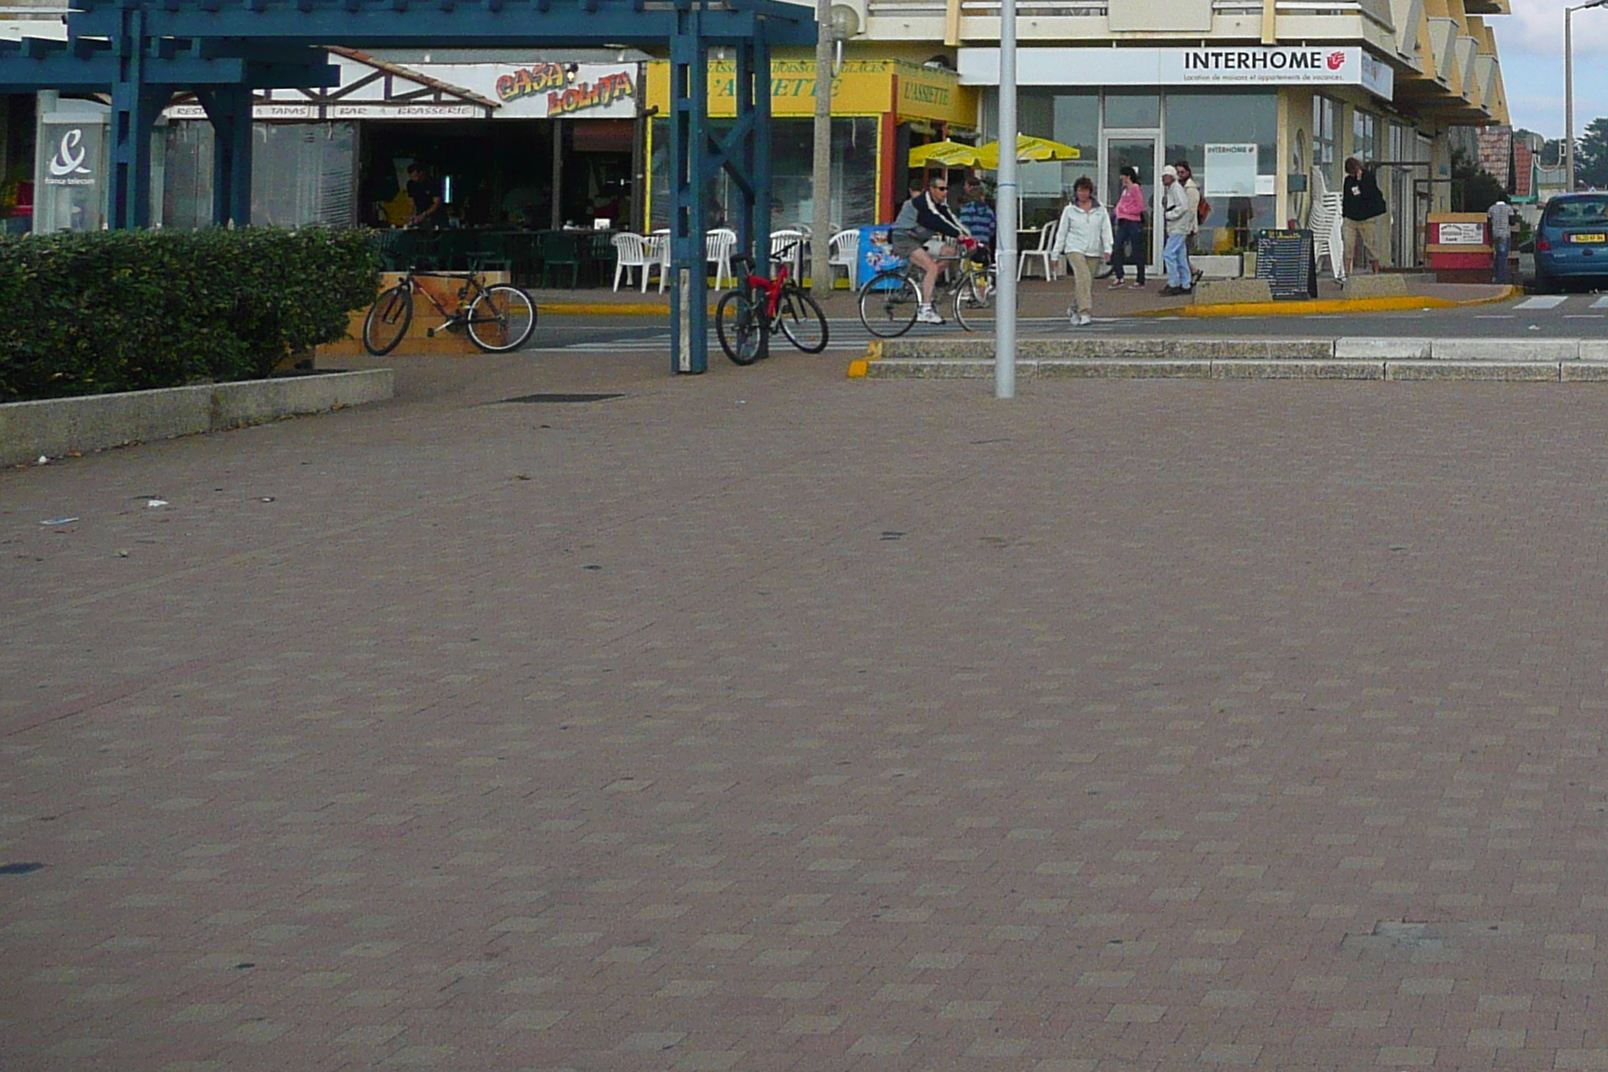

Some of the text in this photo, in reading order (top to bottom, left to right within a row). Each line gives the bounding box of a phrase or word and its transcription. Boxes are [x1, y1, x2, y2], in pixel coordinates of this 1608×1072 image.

[1184, 51, 1322, 69] INTERHOME
[495, 63, 567, 102] CASA
[547, 71, 635, 117] LOLITA
[270, 107, 307, 115] TAPAS
[339, 107, 368, 116] BAR
[397, 107, 469, 116] BRASSERIE
